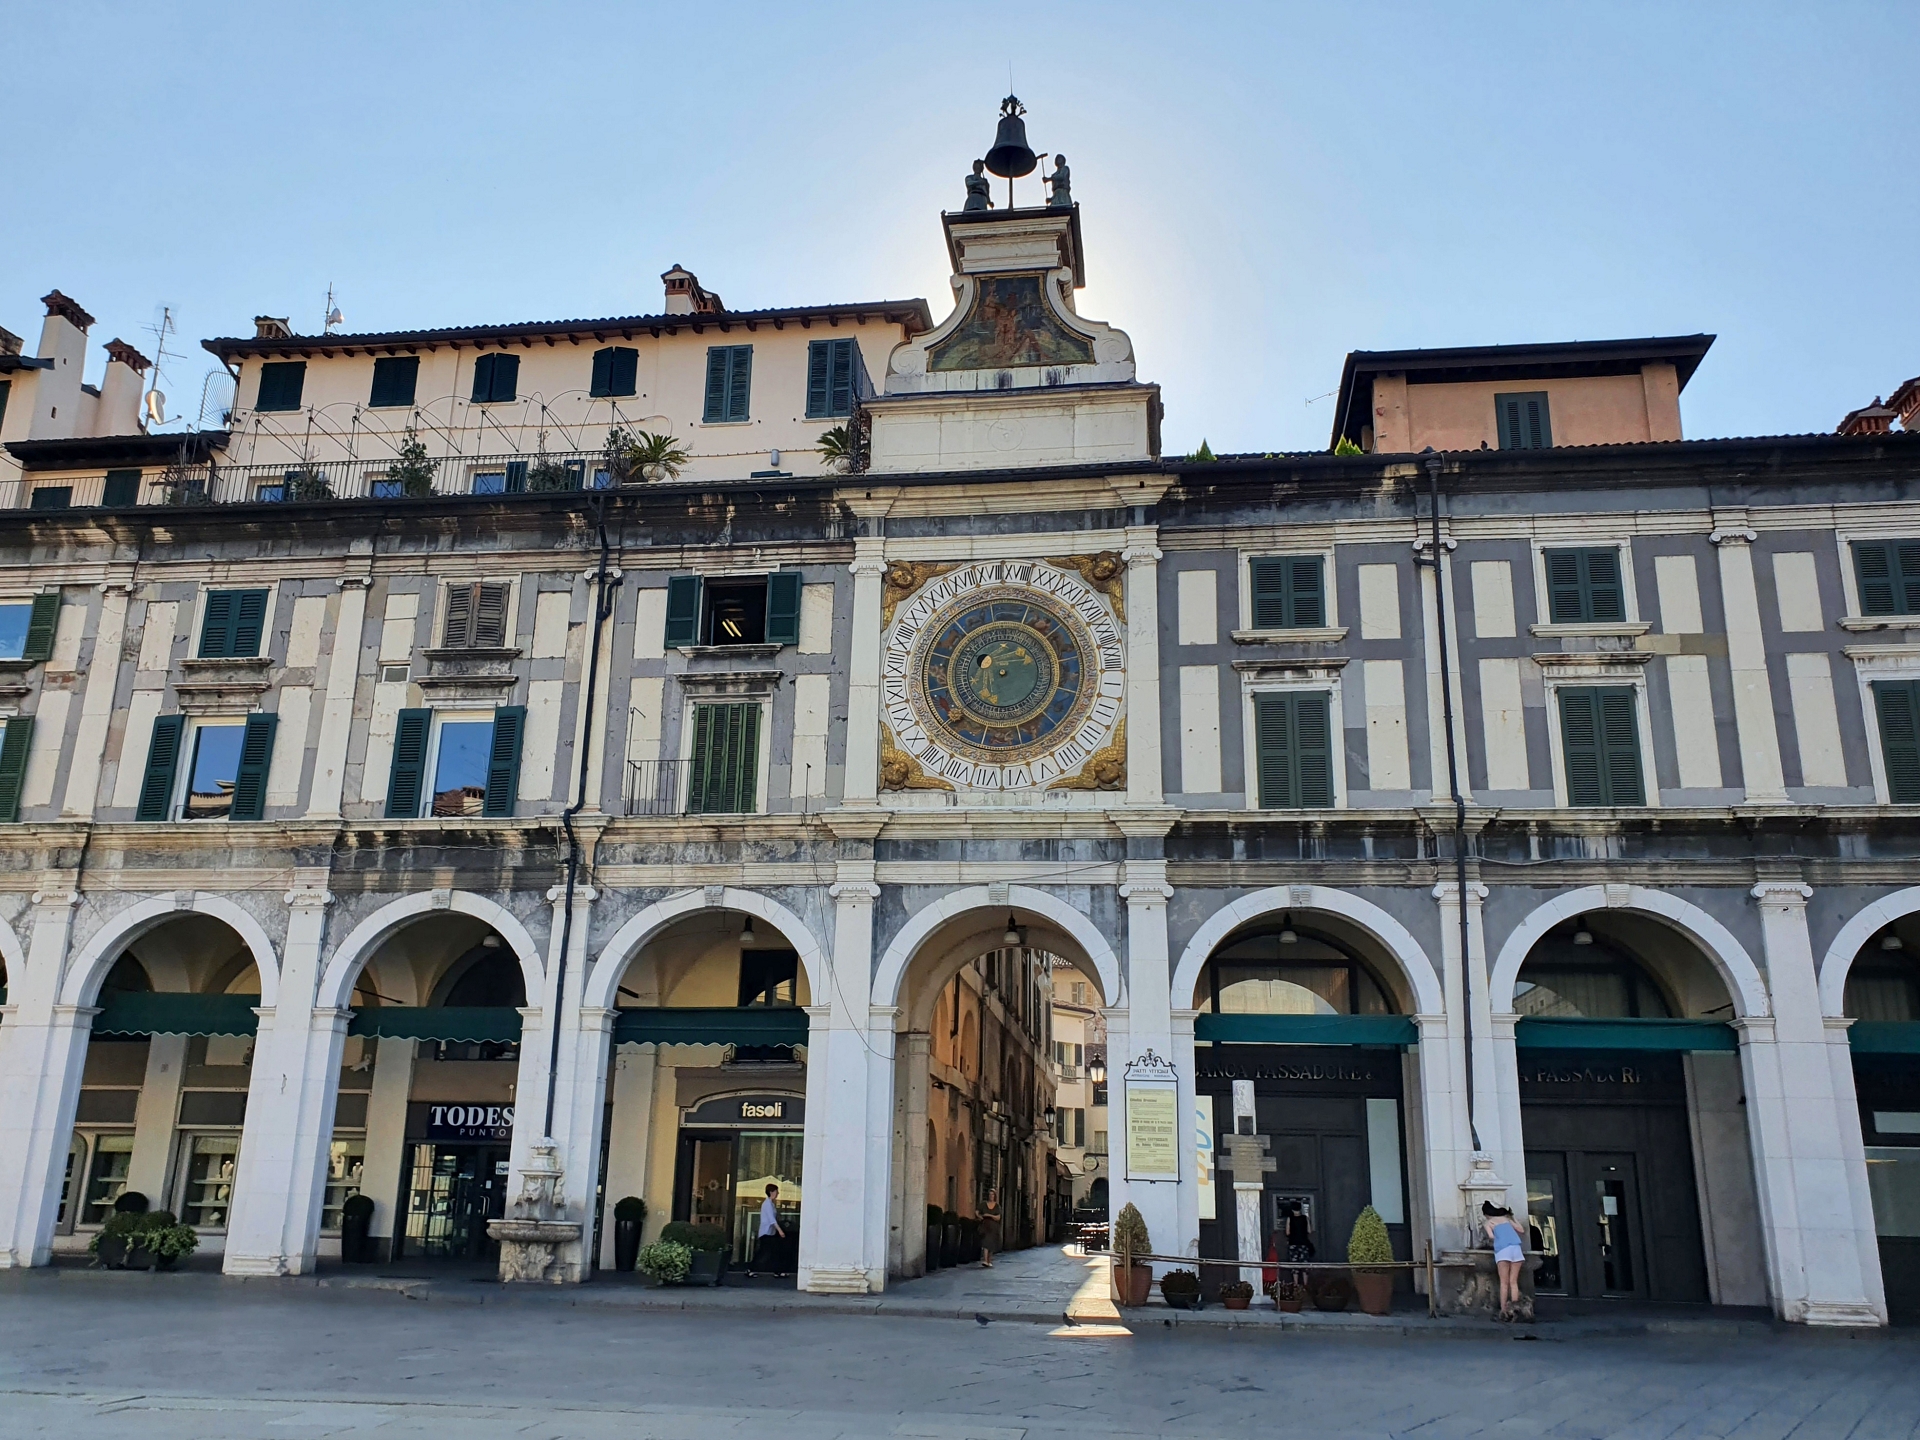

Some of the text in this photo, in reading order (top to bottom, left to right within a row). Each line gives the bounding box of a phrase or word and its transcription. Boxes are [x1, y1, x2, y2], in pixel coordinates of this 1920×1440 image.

[1032, 568, 1057, 590] XX
[924, 582, 951, 607] XVI
[1056, 578, 1082, 601] XXI
[905, 601, 928, 627] XV
[1076, 595, 1102, 621] XXII
[887, 653, 905, 674] XIII
[886, 680, 904, 701] XII
[891, 707, 913, 727] XI
[905, 731, 925, 748] X
[976, 768, 998, 787] VII
[1041, 763, 1054, 779] V
[1195, 1063, 1248, 1078] ANCA
[431, 1106, 515, 1126] TODES
[742, 1102, 782, 1117] fasoli
[460, 1128, 506, 1136] PUNTO
